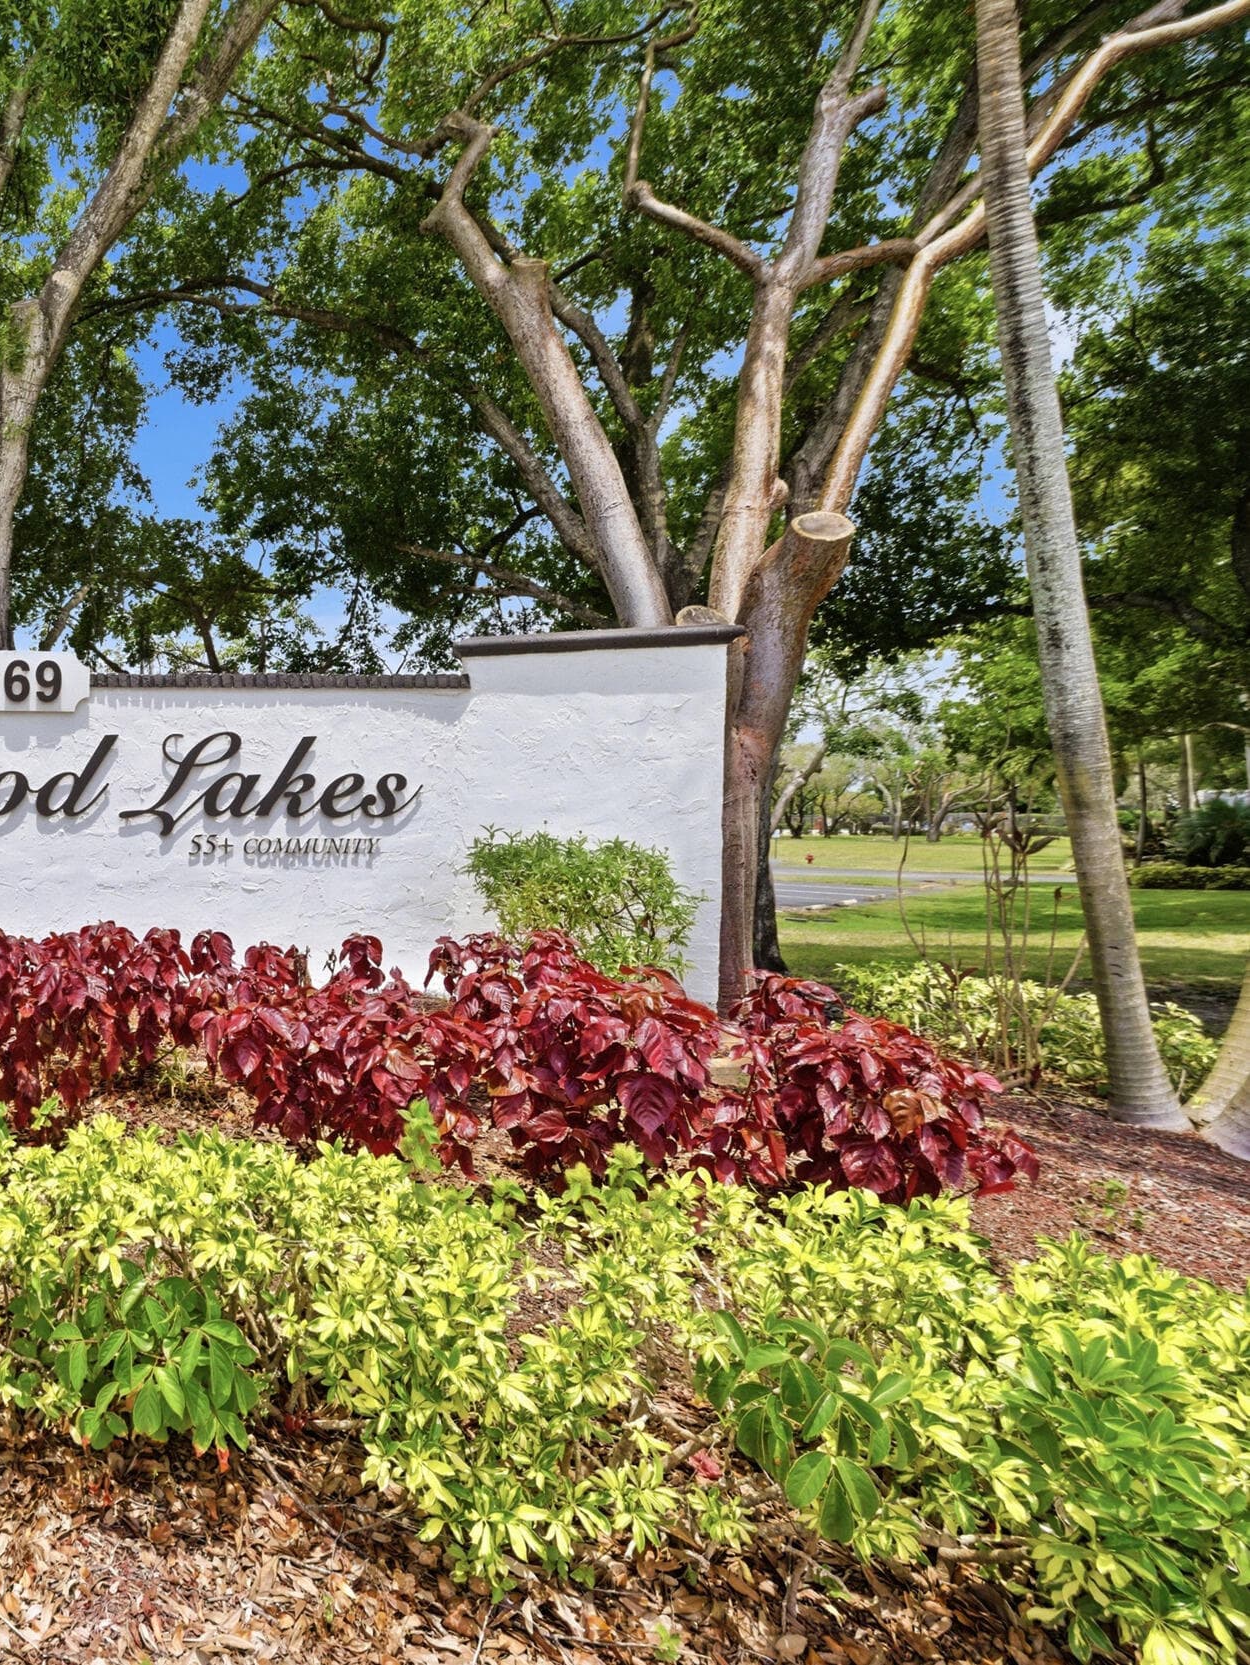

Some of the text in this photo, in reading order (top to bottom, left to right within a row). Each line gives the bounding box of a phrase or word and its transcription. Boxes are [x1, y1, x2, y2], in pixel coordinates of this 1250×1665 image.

[119, 731, 423, 836] Lakes
[188, 834, 381, 856] 55+ COMMUNITY
